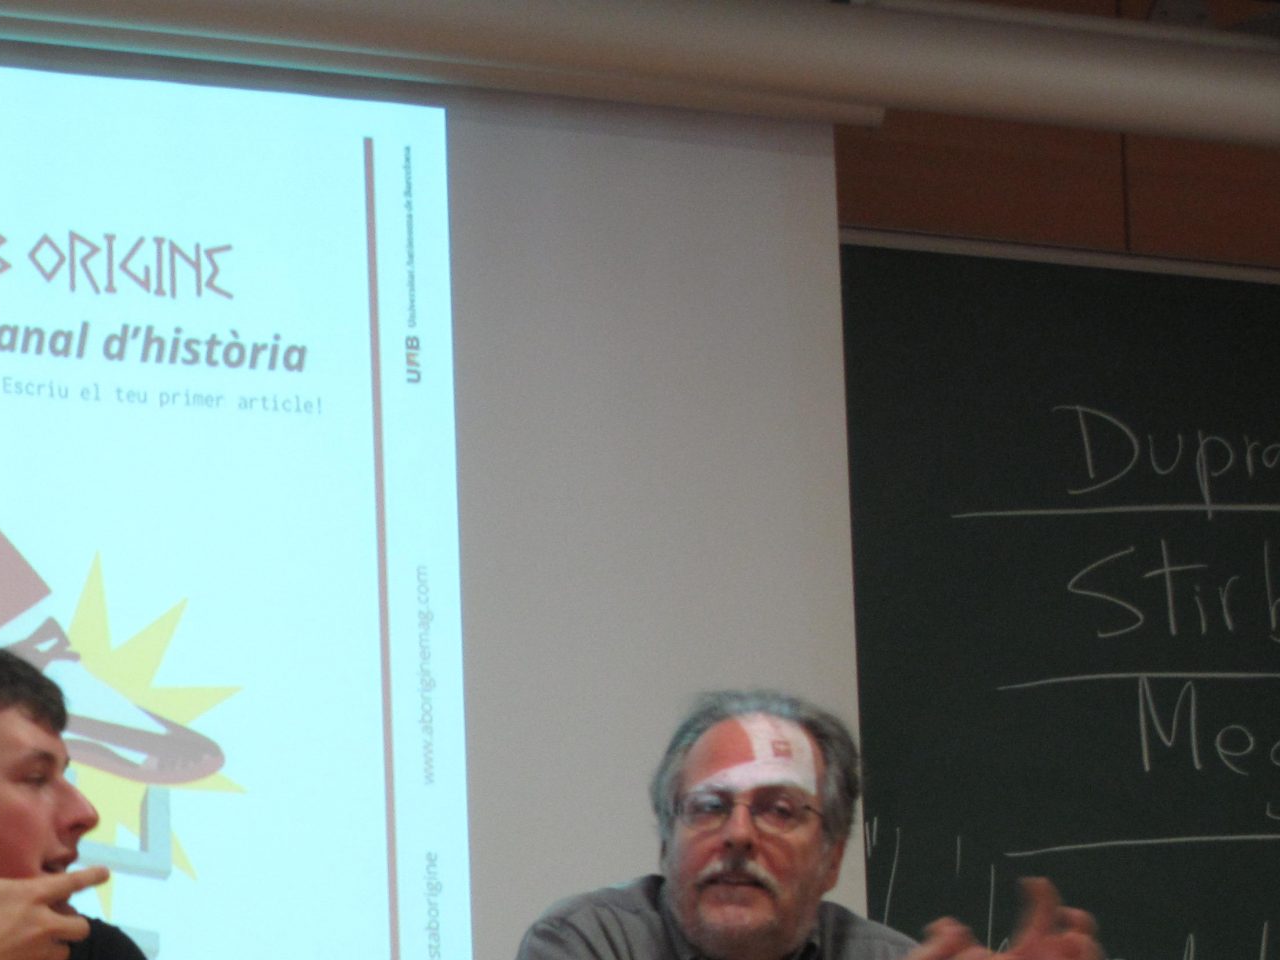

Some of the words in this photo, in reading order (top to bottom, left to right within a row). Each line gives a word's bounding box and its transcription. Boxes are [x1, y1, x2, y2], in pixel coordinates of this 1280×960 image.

[28, 229, 236, 300] ORIGINE
[102, 323, 307, 373] d'història
[2, 376, 68, 399] Escriu
[80, 383, 101, 401] el
[115, 386, 148, 404] teu
[159, 388, 224, 408] primer
[238, 394, 322, 414] article!
[415, 565, 436, 785] www.aboriginemag.com
